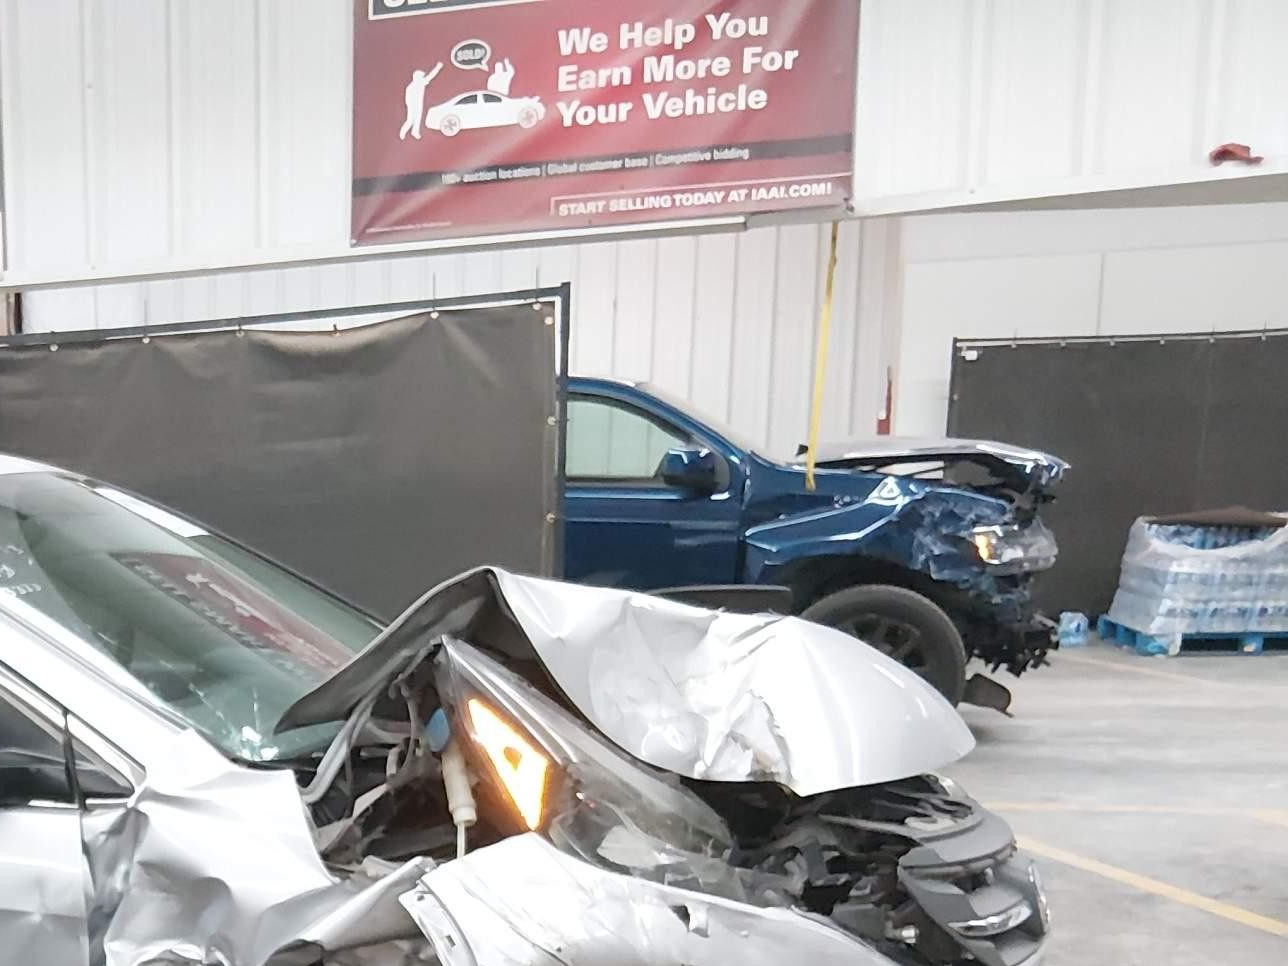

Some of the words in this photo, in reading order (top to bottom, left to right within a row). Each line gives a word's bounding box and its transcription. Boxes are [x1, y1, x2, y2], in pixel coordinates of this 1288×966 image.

[558, 28, 609, 56] We
[619, 19, 696, 50] Help
[705, 12, 769, 40] You
[557, 64, 632, 92] Earn
[643, 54, 731, 84] More
[742, 46, 799, 74] For
[556, 100, 633, 128] Your
[642, 83, 768, 120] Vehicle
[559, 201, 606, 217] START
[609, 195, 671, 213] SELLING
[674, 190, 723, 207] TODAY
[727, 188, 749, 203] AT
[751, 182, 832, 201] IAAI.COM!
